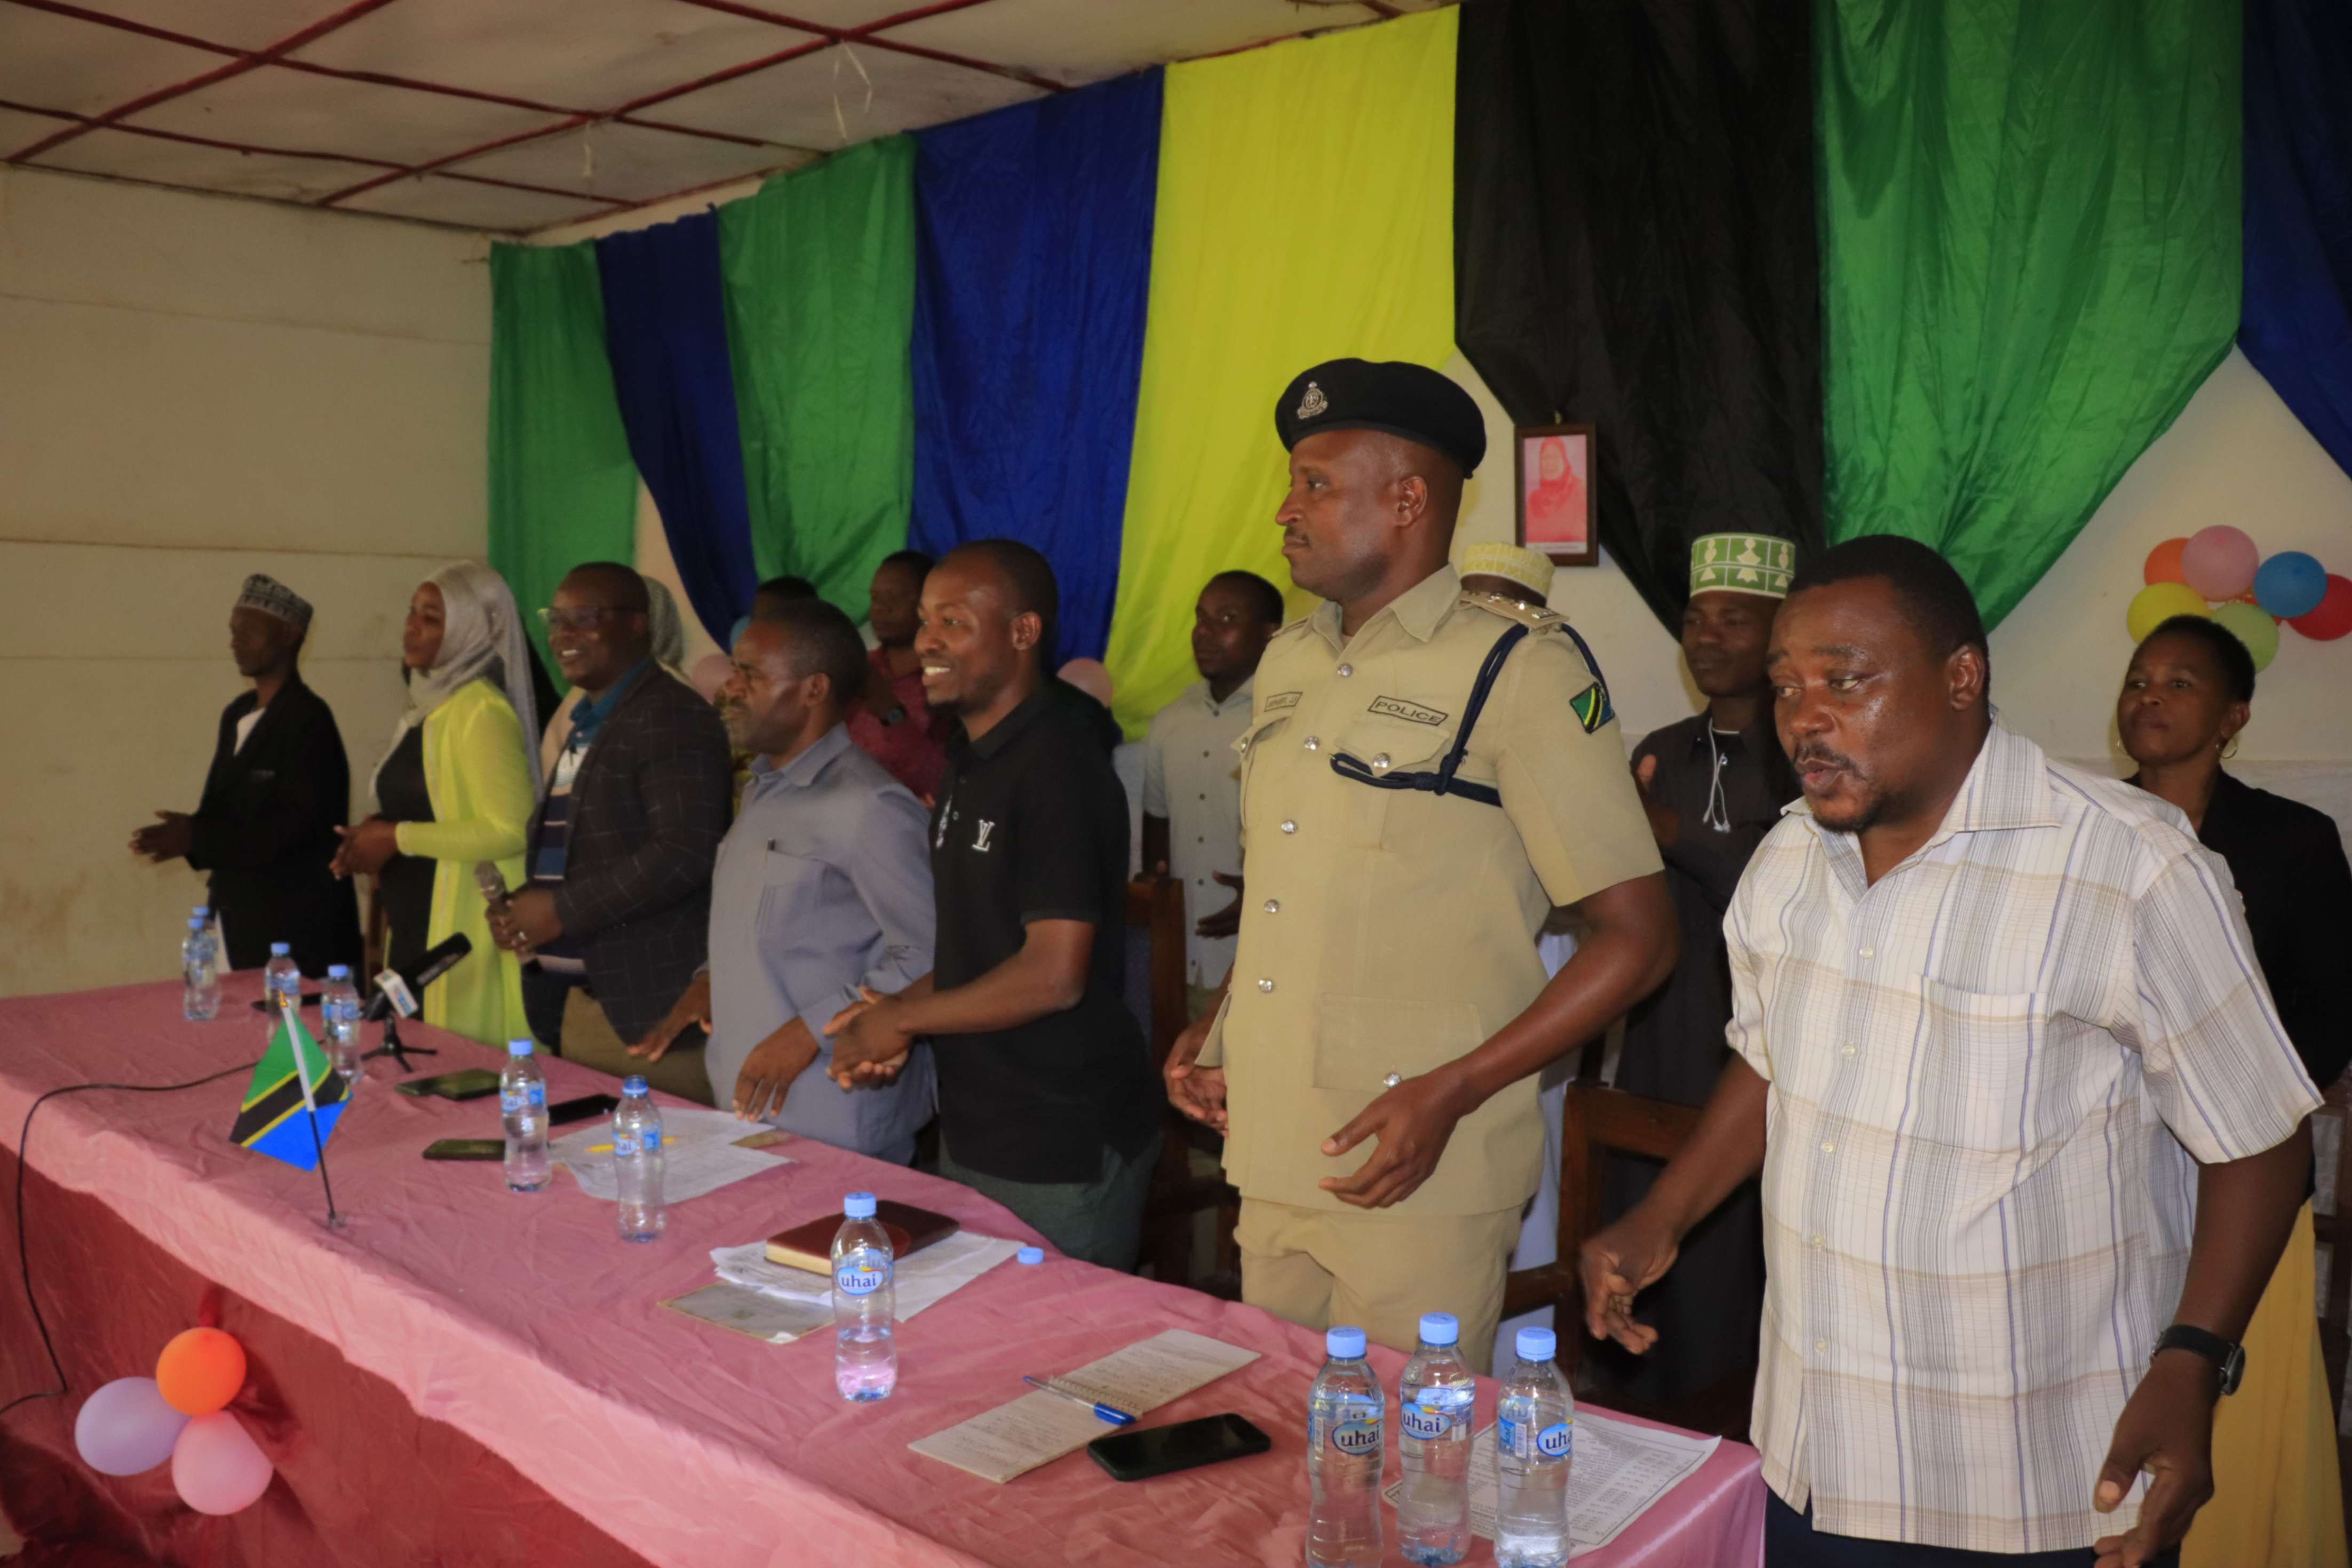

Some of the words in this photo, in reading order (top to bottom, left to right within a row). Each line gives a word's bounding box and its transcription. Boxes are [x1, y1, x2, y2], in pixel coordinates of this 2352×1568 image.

[1374, 701, 1442, 722] POLICE
[841, 1273, 877, 1287] uhai
[1403, 1412, 1441, 1432] uhai
[1341, 1424, 1379, 1447] uhai
